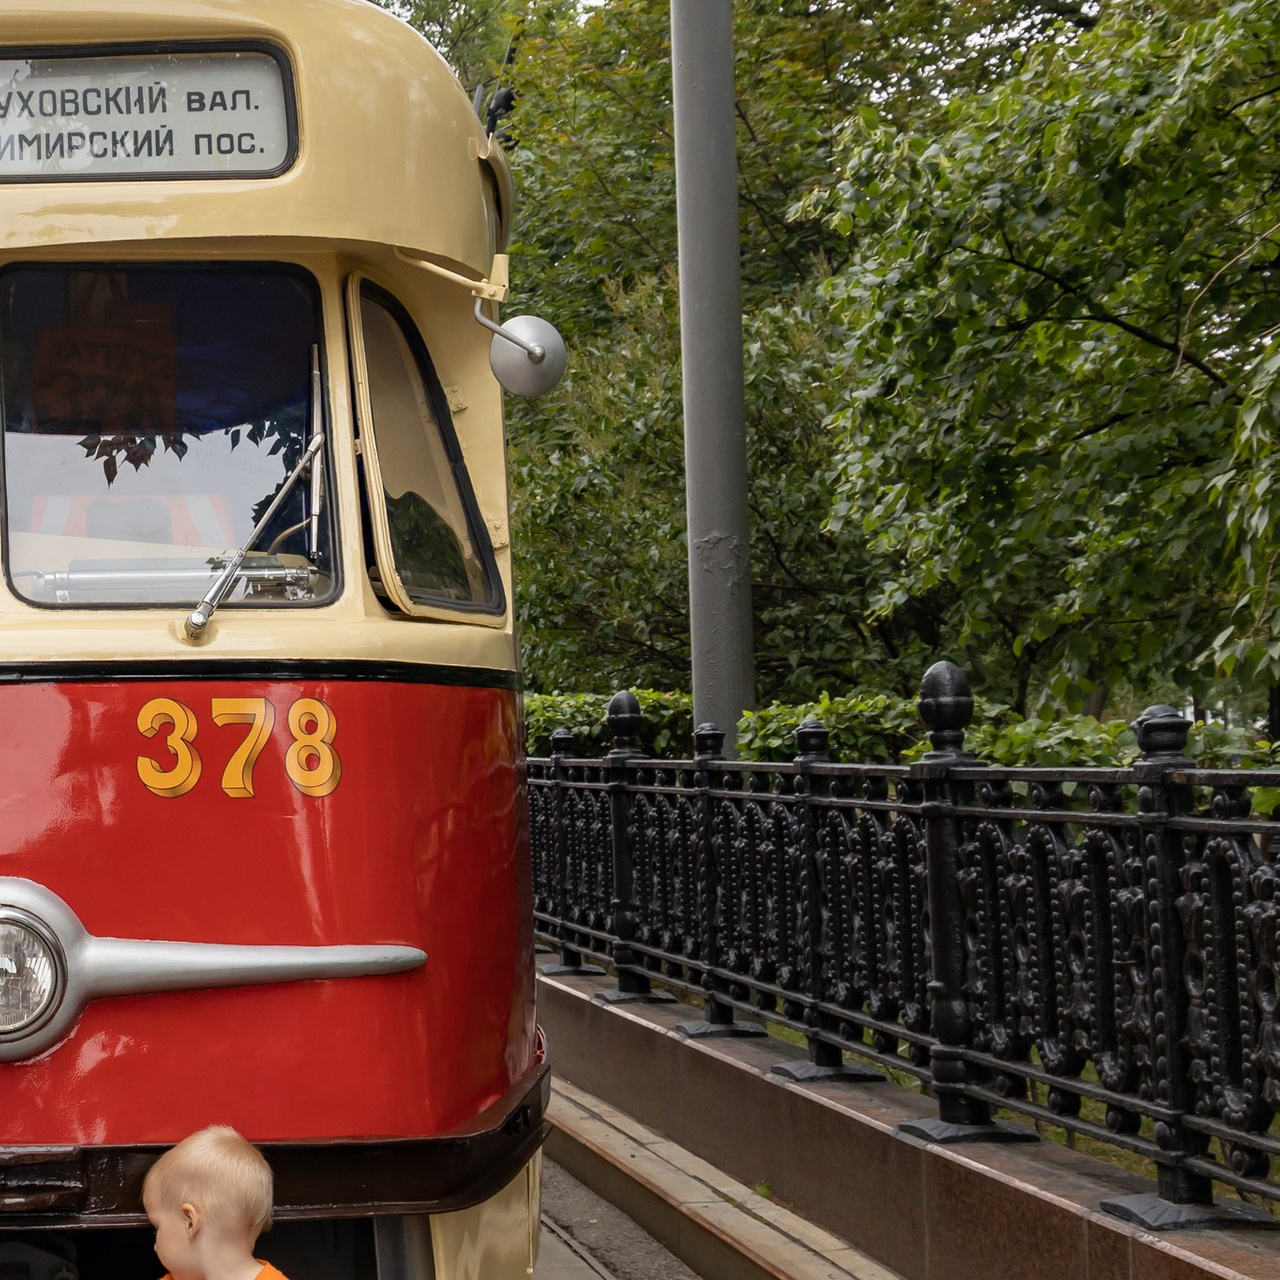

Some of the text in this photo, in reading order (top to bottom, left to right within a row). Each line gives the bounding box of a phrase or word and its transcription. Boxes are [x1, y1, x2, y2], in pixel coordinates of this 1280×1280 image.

[186, 89, 260, 112] ВАЛ.
[194, 132, 266, 156] ПОС.
[136, 697, 342, 799] 378
